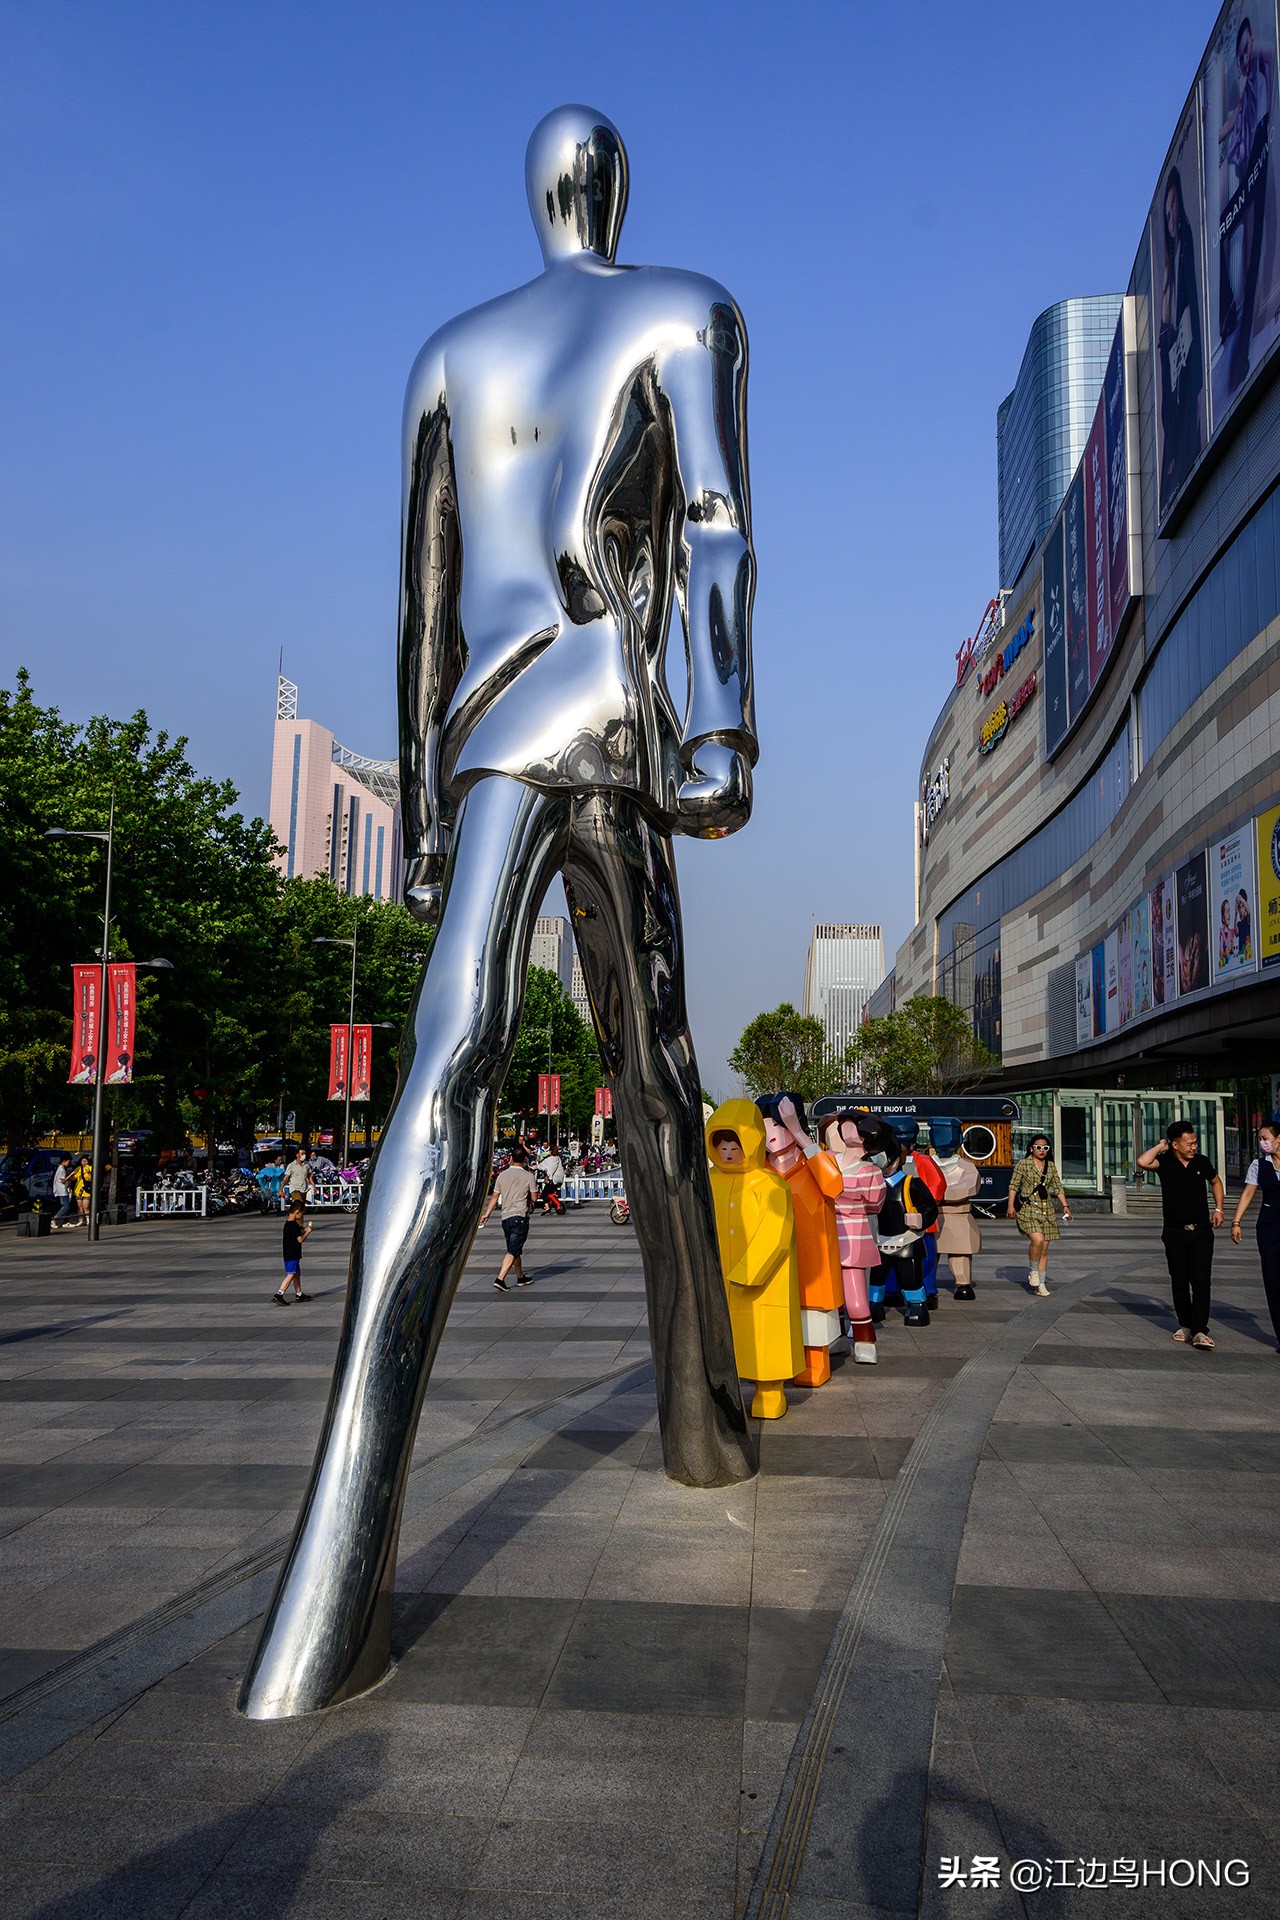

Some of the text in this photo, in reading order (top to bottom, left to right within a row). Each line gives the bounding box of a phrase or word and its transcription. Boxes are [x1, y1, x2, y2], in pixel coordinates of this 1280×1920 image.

[1212, 126, 1275, 248] URBAN REVIVO
[1268, 896, 1280, 916] 狮
